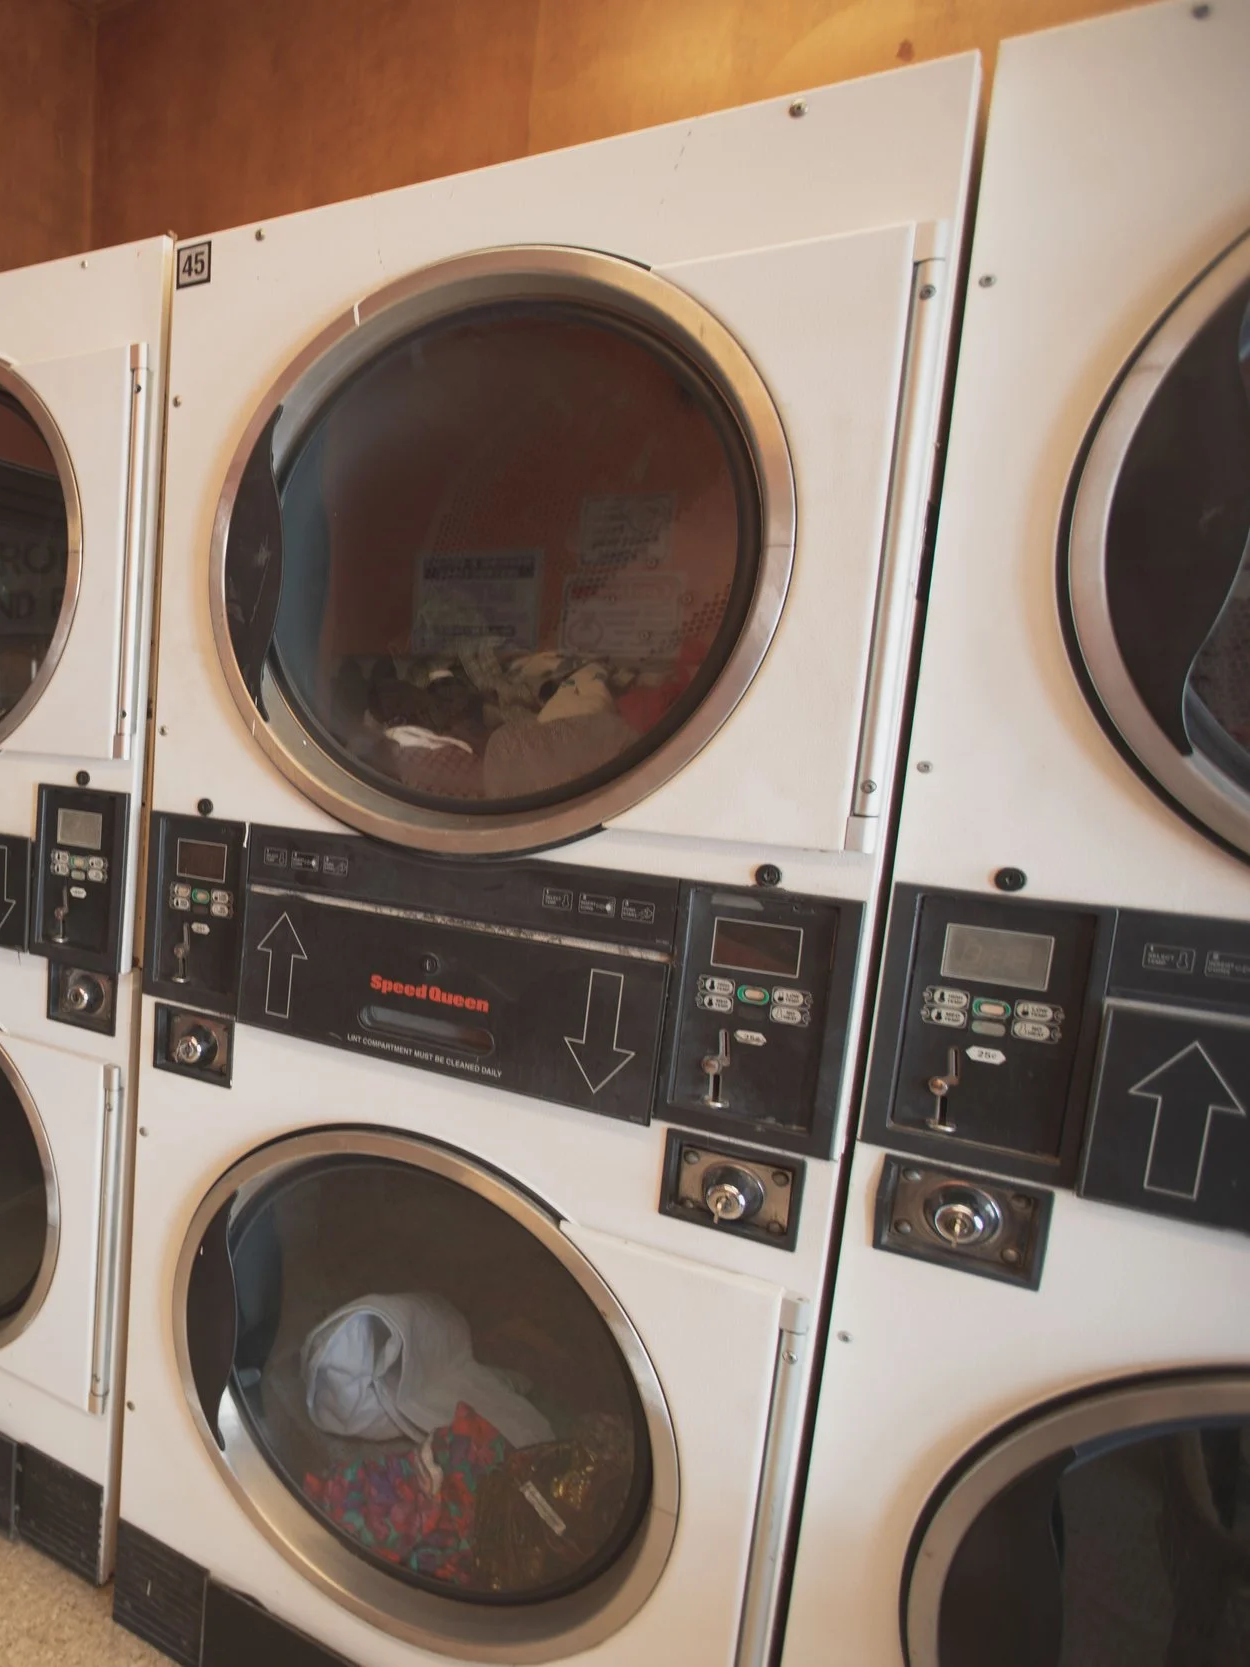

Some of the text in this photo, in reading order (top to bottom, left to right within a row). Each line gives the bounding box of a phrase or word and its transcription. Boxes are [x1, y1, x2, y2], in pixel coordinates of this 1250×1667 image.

[182, 251, 205, 278] 45
[370, 974, 490, 1013] Speed Queen
[347, 1033, 502, 1078] LINT COMPARTMENT MUST BE CLEANED DAILY
